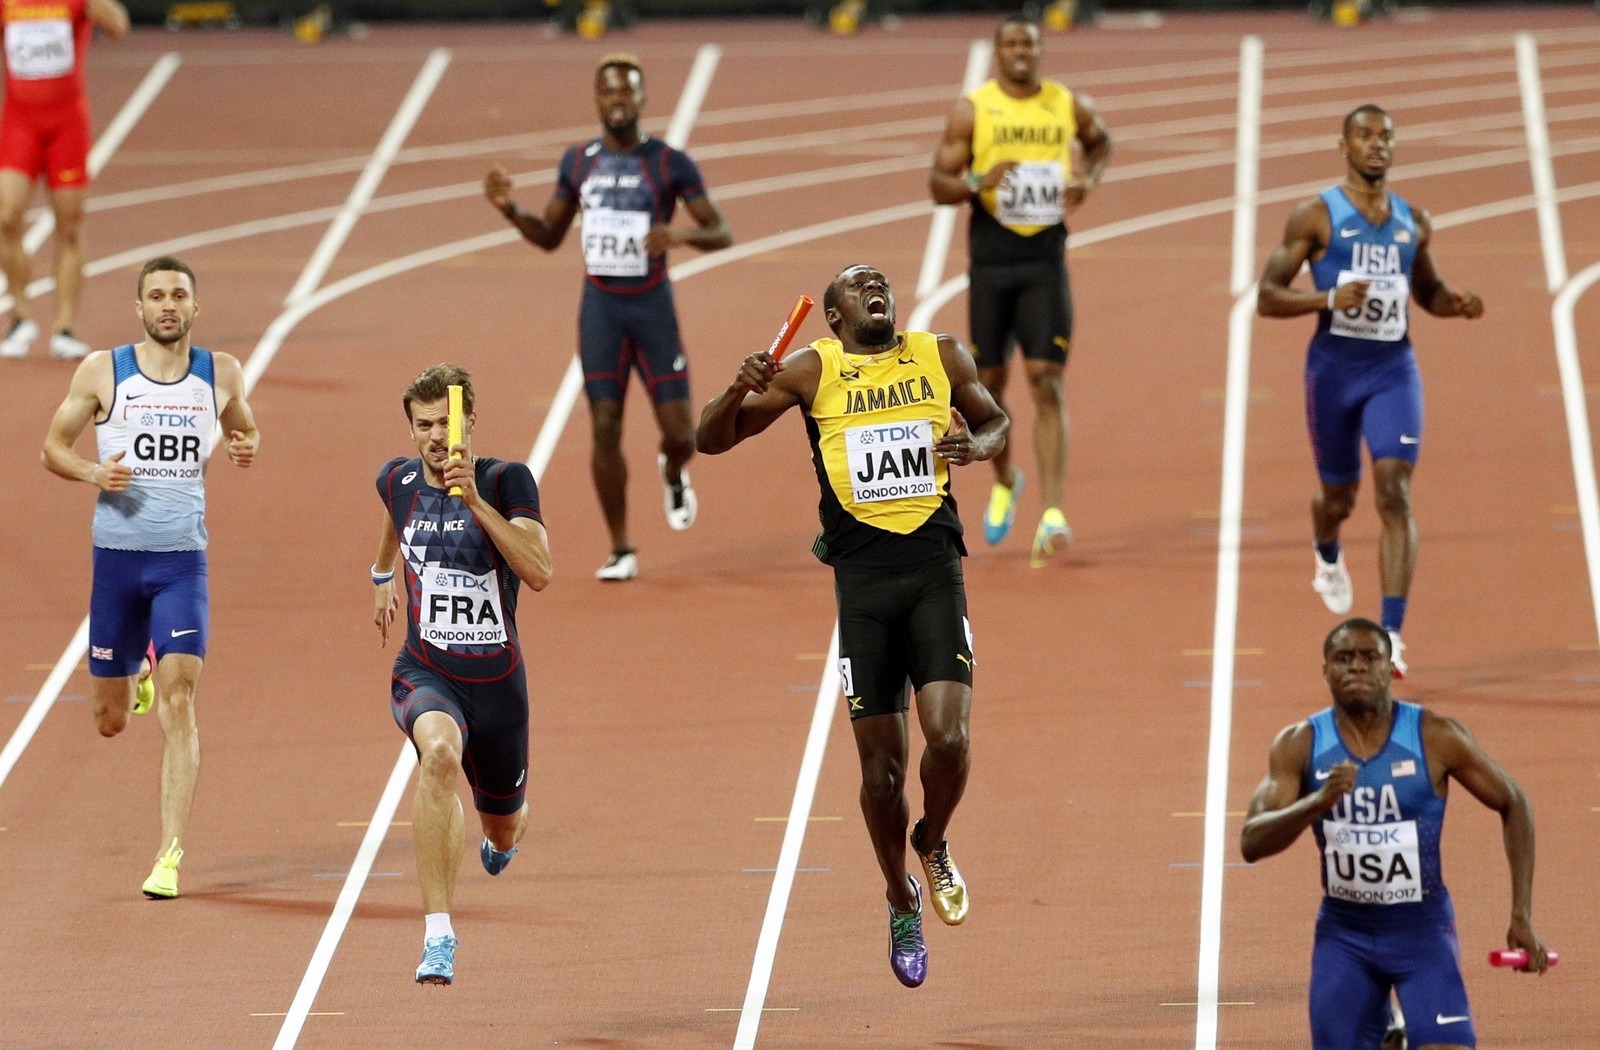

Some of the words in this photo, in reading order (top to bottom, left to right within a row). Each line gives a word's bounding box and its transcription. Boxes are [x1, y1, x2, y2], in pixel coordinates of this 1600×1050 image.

[993, 126, 1062, 145] JAMAICA
[1003, 186, 1057, 208] JAM
[587, 234, 639, 257] FRA
[1351, 242, 1400, 274] USA
[843, 376, 935, 414] JAMAICA
[154, 413, 196, 428] TDK
[873, 425, 920, 443] TDK
[134, 432, 200, 462] GBR
[132, 467, 177, 478] ONDON
[179, 469, 200, 478] 2017
[857, 447, 929, 483] JAM
[856, 485, 909, 500] LONDON
[911, 483, 933, 494] 2017
[447, 572, 489, 592] TDK
[429, 594, 500, 626] FRA
[424, 629, 475, 642] LONDON
[477, 630, 502, 641] 2017
[1331, 783, 1402, 824] USA
[1351, 828, 1400, 845] TDK
[1333, 850, 1413, 884] USA
[1331, 884, 1384, 901] LONDON
[1385, 888, 1417, 900] 2017
